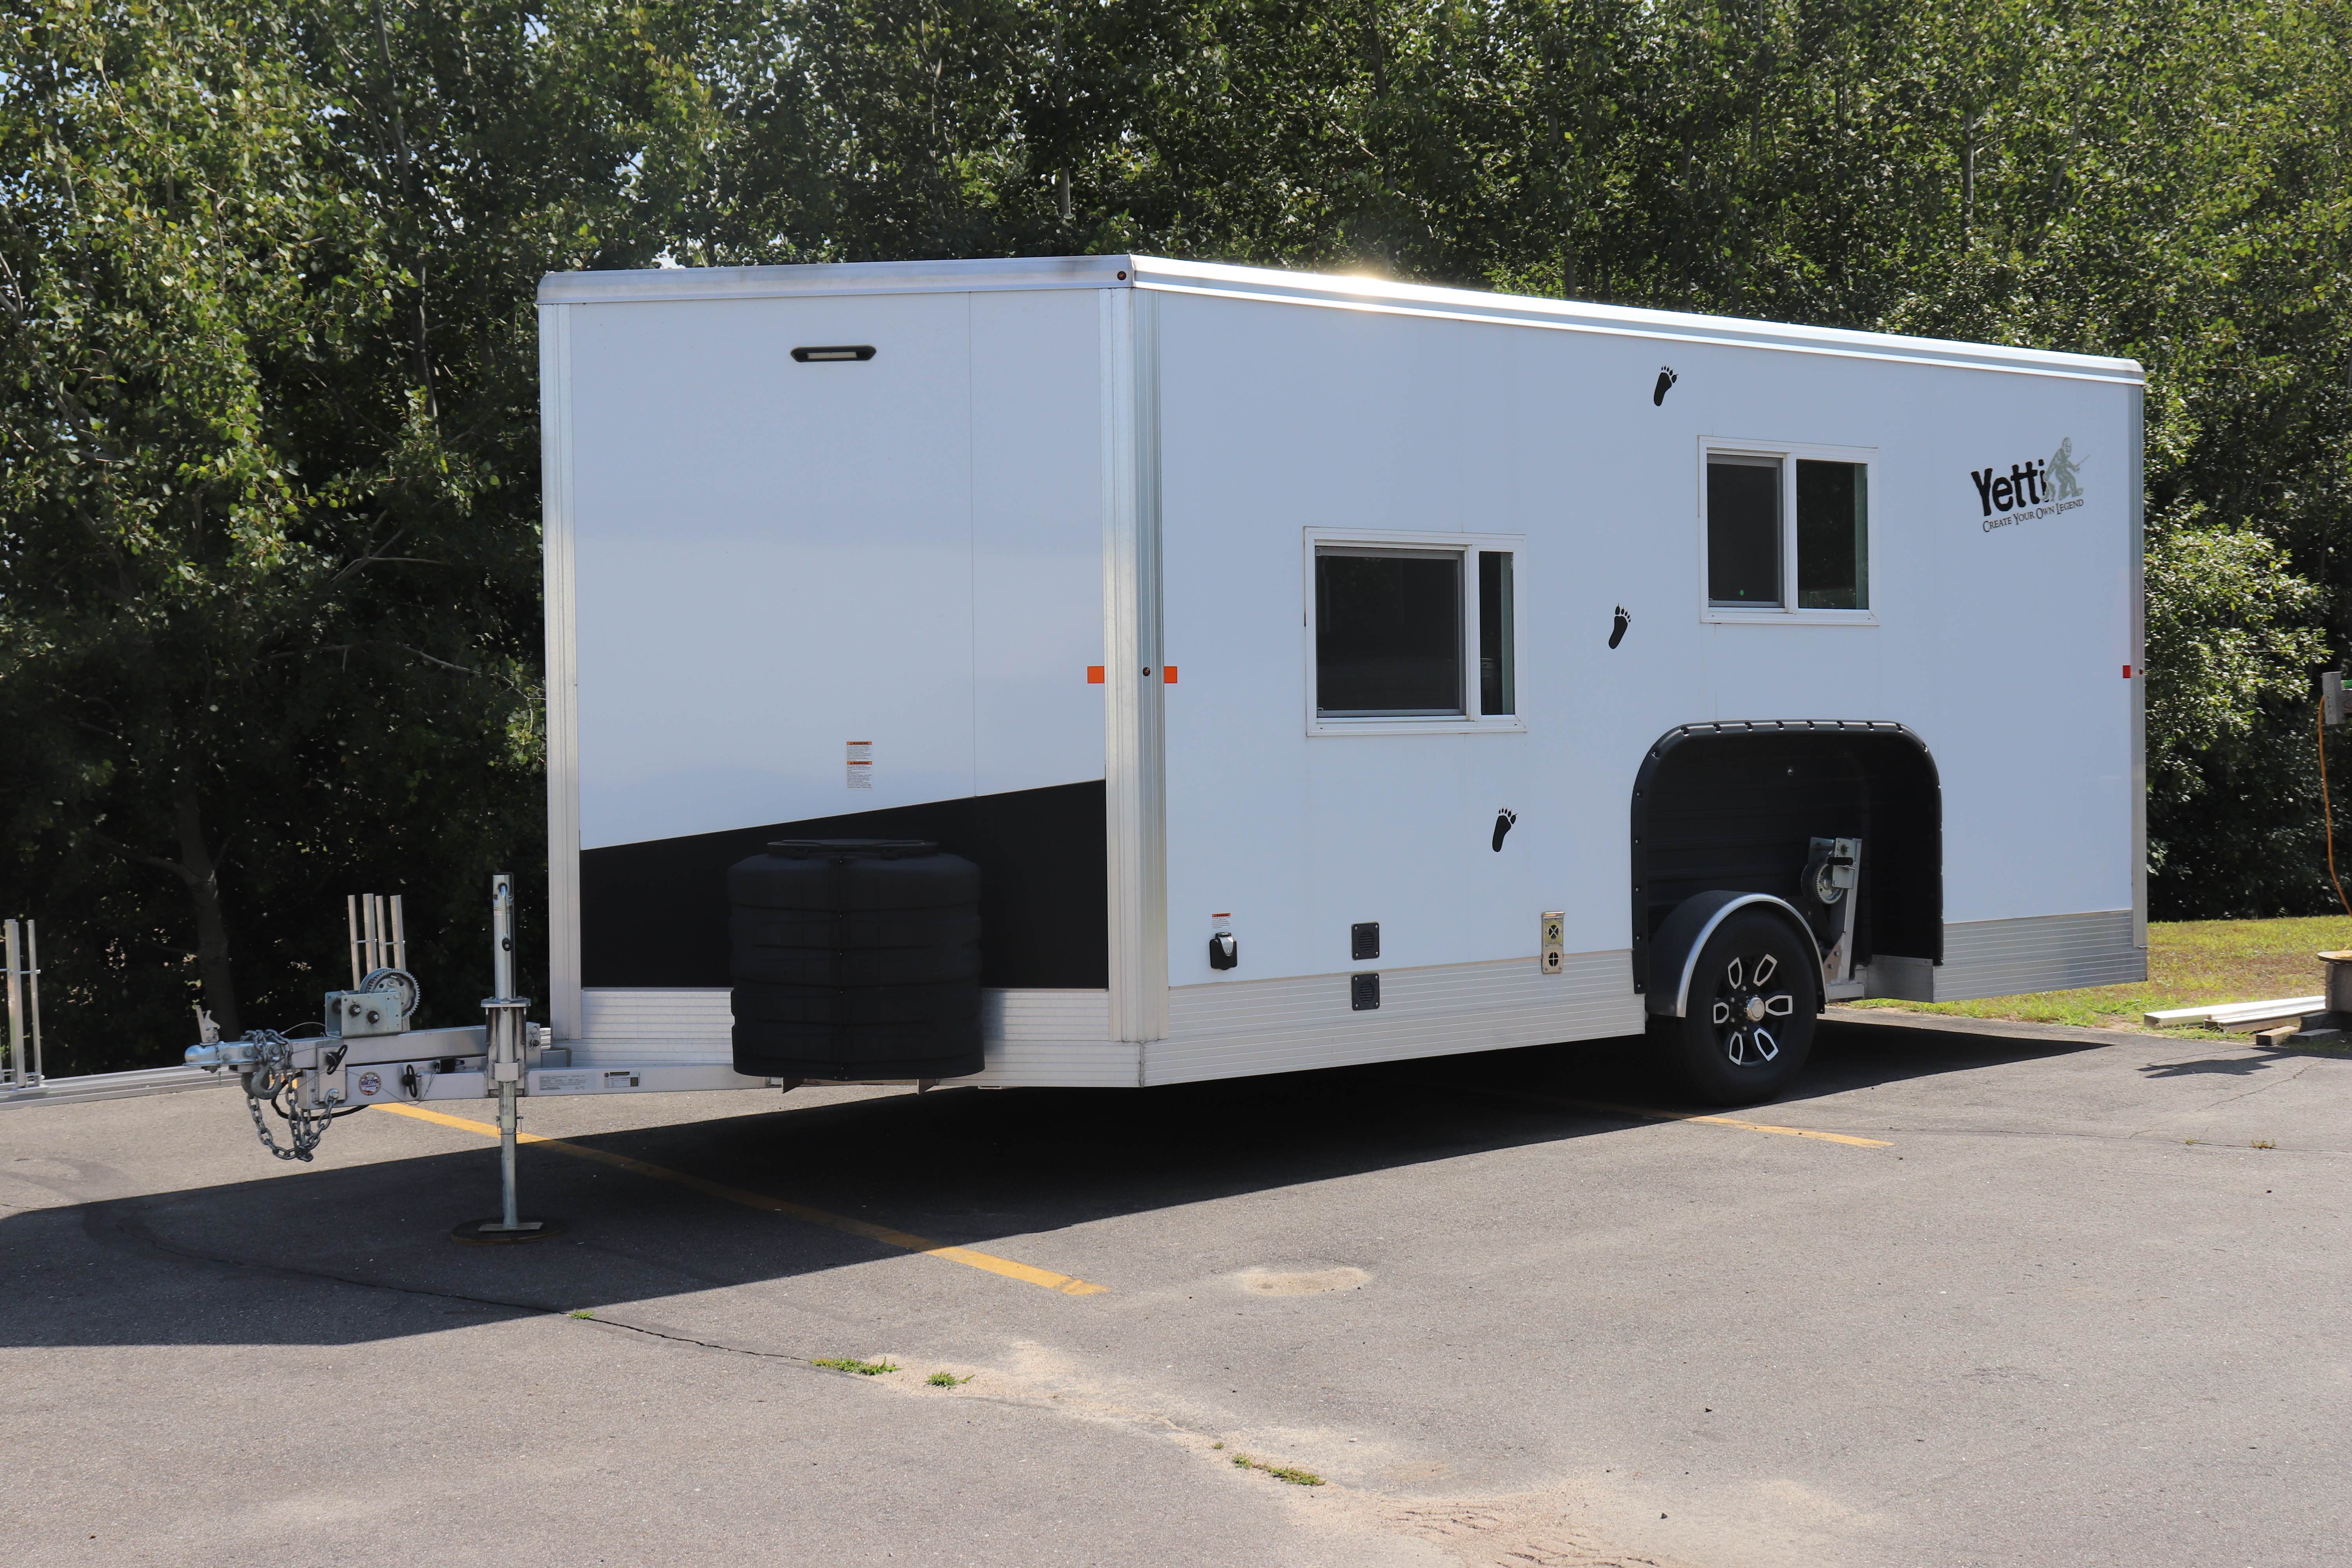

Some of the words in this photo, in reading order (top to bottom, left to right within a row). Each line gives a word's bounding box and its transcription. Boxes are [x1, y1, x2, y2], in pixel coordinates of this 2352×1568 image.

[1971, 459, 2049, 516] Yetti
[1983, 517, 2012, 532] CREATE
[2013, 511, 2035, 525] YOUR
[2036, 506, 2055, 519] OWN
[2056, 499, 2084, 514] LEGEND
